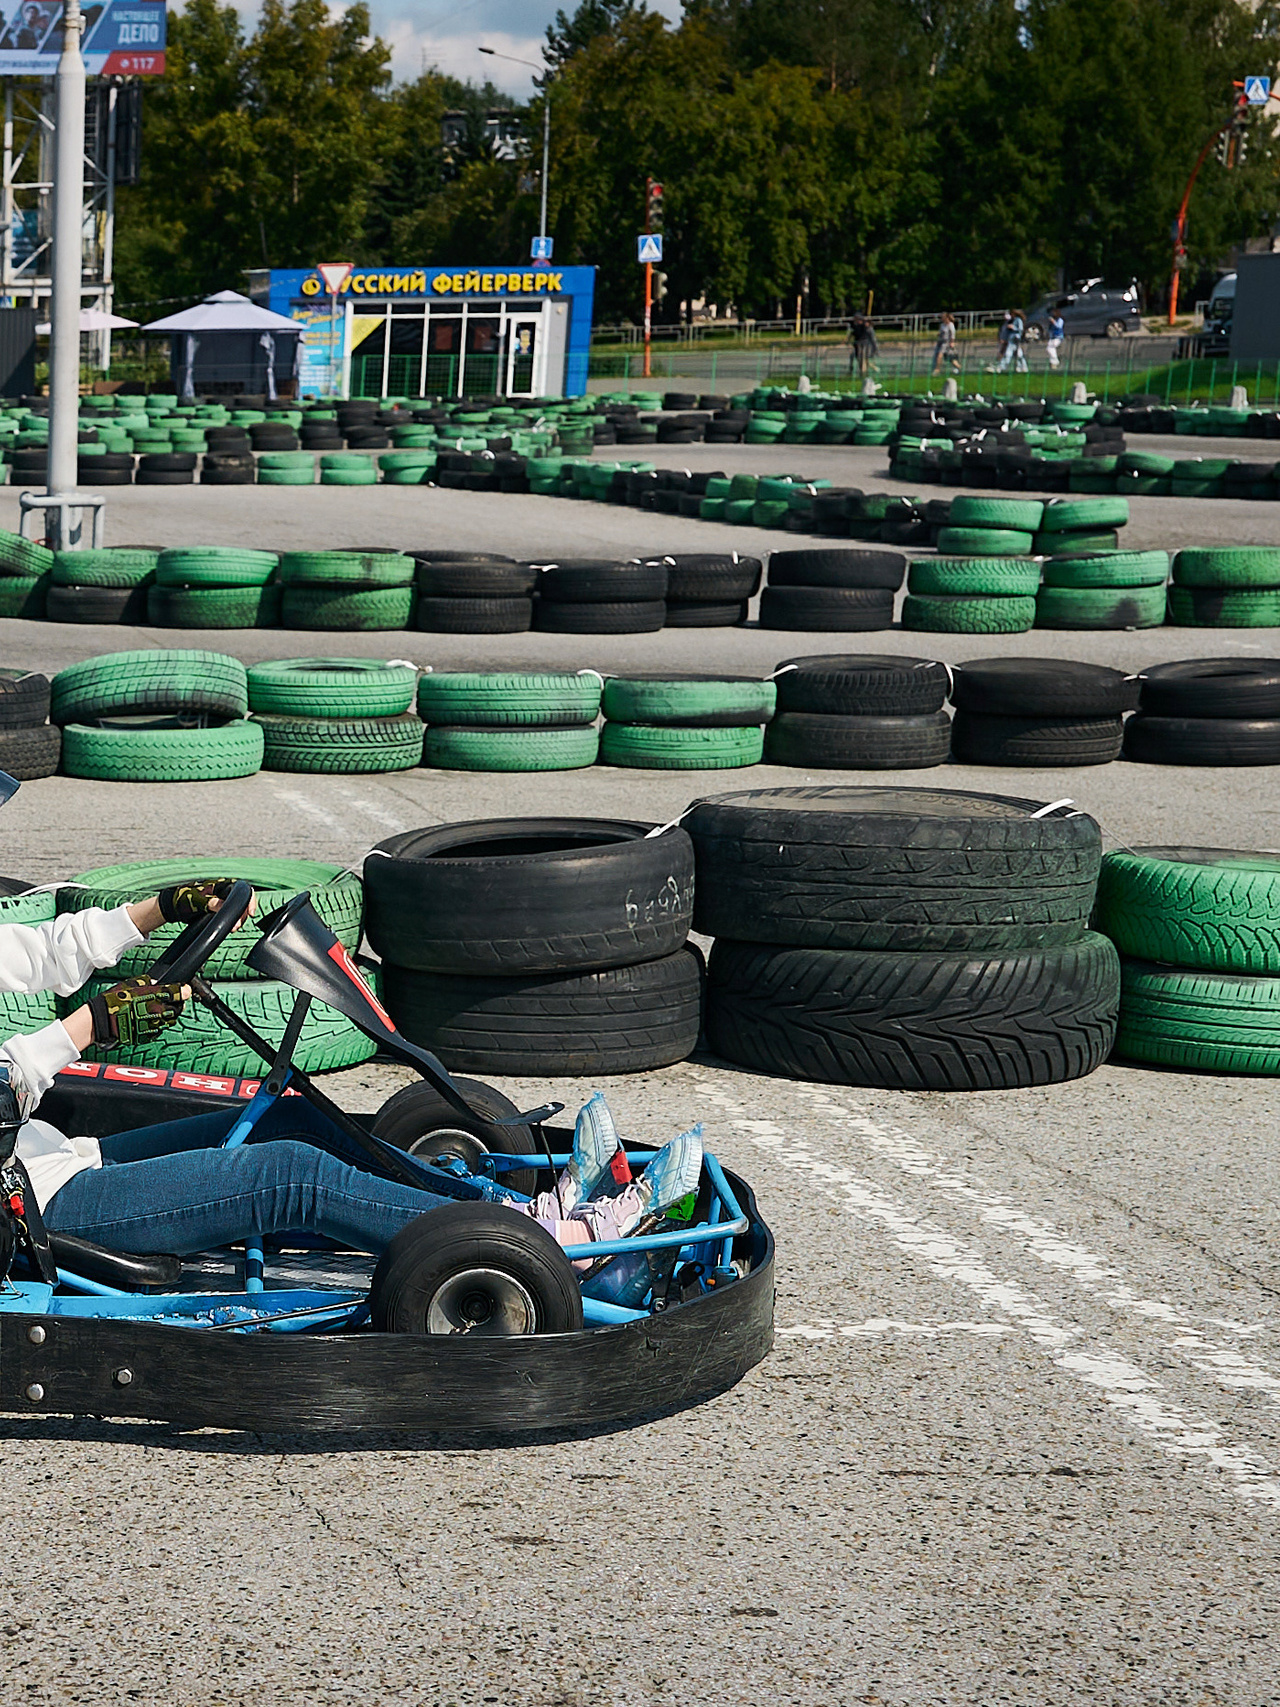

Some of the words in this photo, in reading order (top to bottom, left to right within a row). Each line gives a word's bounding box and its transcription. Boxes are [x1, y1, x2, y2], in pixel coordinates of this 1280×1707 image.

[118, 23, 159, 44] ДЕЛО
[131, 57, 155, 70] 117
[431, 270, 563, 294] ФЕЙЕРВЕРК
